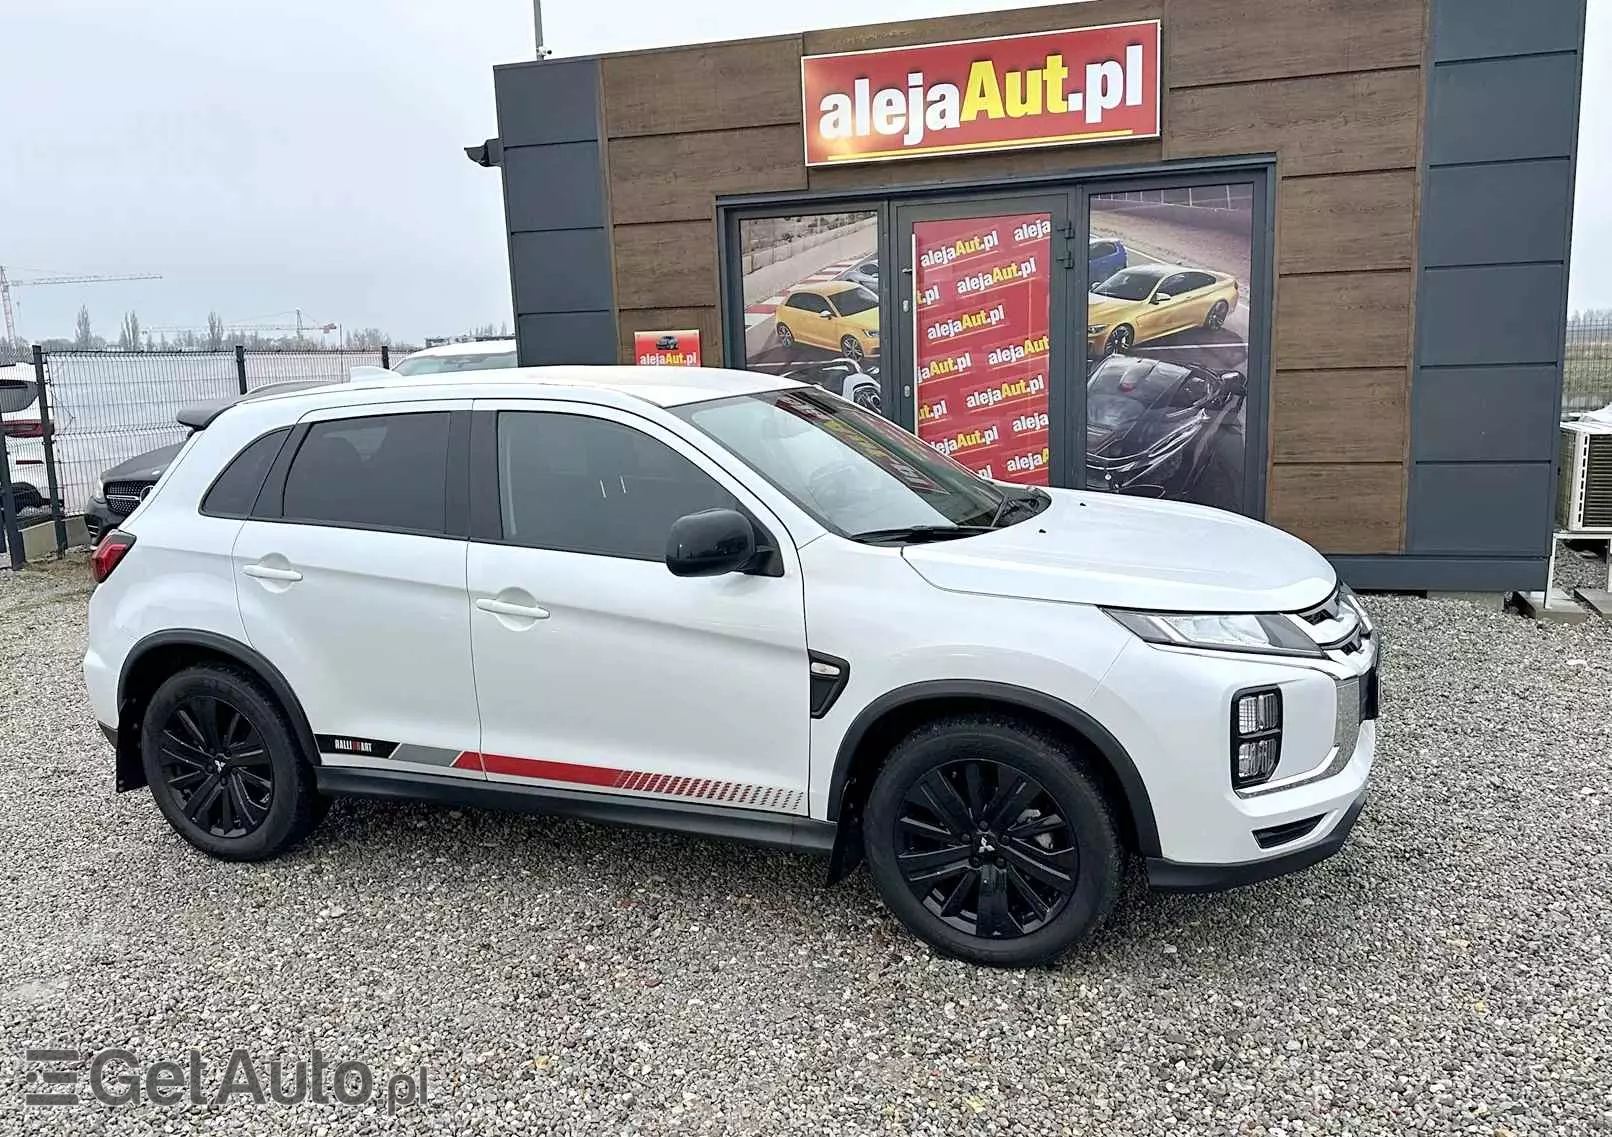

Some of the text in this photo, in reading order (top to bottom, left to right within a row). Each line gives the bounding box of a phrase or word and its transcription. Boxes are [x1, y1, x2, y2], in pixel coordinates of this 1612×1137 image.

[819, 45, 1143, 145] alejaAut.pl
[920, 231, 999, 267] alejaAut.pl
[957, 257, 1036, 293] alejaAut.pl
[927, 305, 1005, 339] alejaAut.pl
[640, 352, 697, 365] alejaAut.pl
[966, 375, 1044, 407] alejaAut.pl
